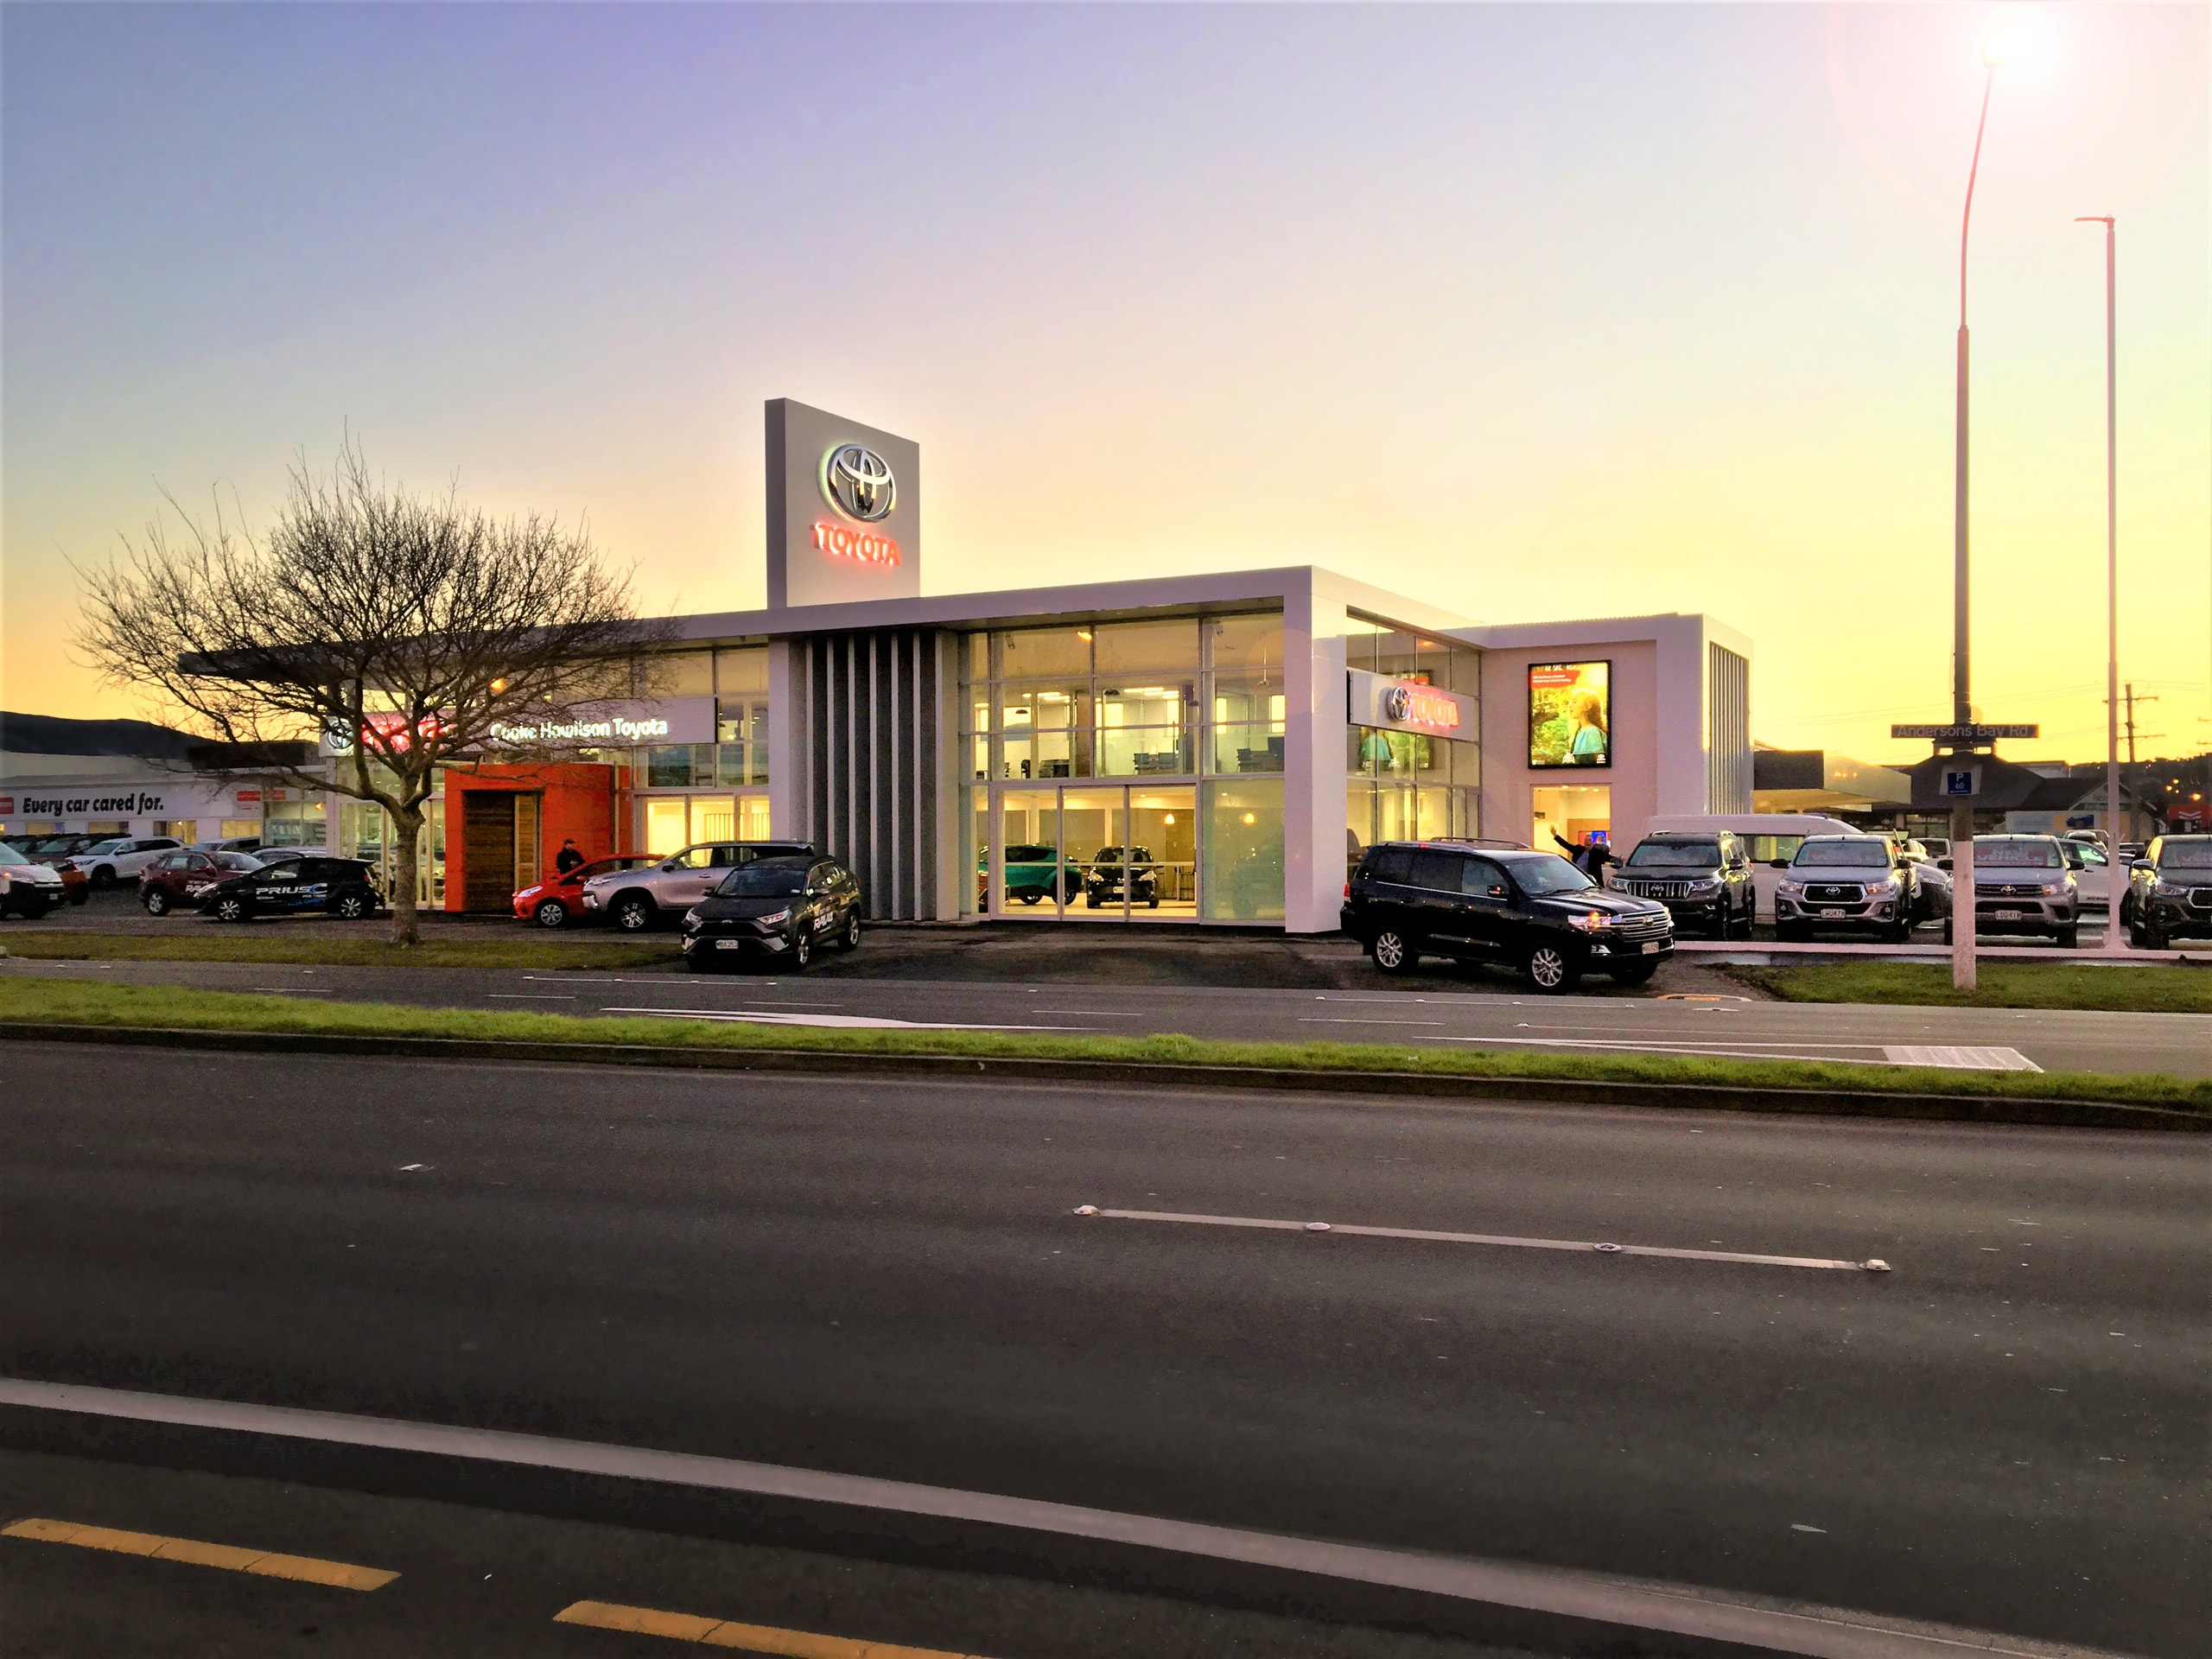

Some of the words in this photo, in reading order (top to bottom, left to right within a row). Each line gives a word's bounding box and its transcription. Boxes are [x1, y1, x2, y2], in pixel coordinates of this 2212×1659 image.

[816, 524, 901, 566] TOYOTA
[1410, 693, 1459, 728] TOYOTA
[612, 717, 669, 741] Toyota
[1897, 725, 1973, 737] Andersons
[1976, 725, 2005, 738] Bay
[2009, 725, 2029, 736] Rd
[1956, 772, 1964, 782] P
[22, 797, 63, 817] Every
[66, 799, 90, 812] car
[92, 793, 135, 812] cared
[137, 792, 164, 815] for.
